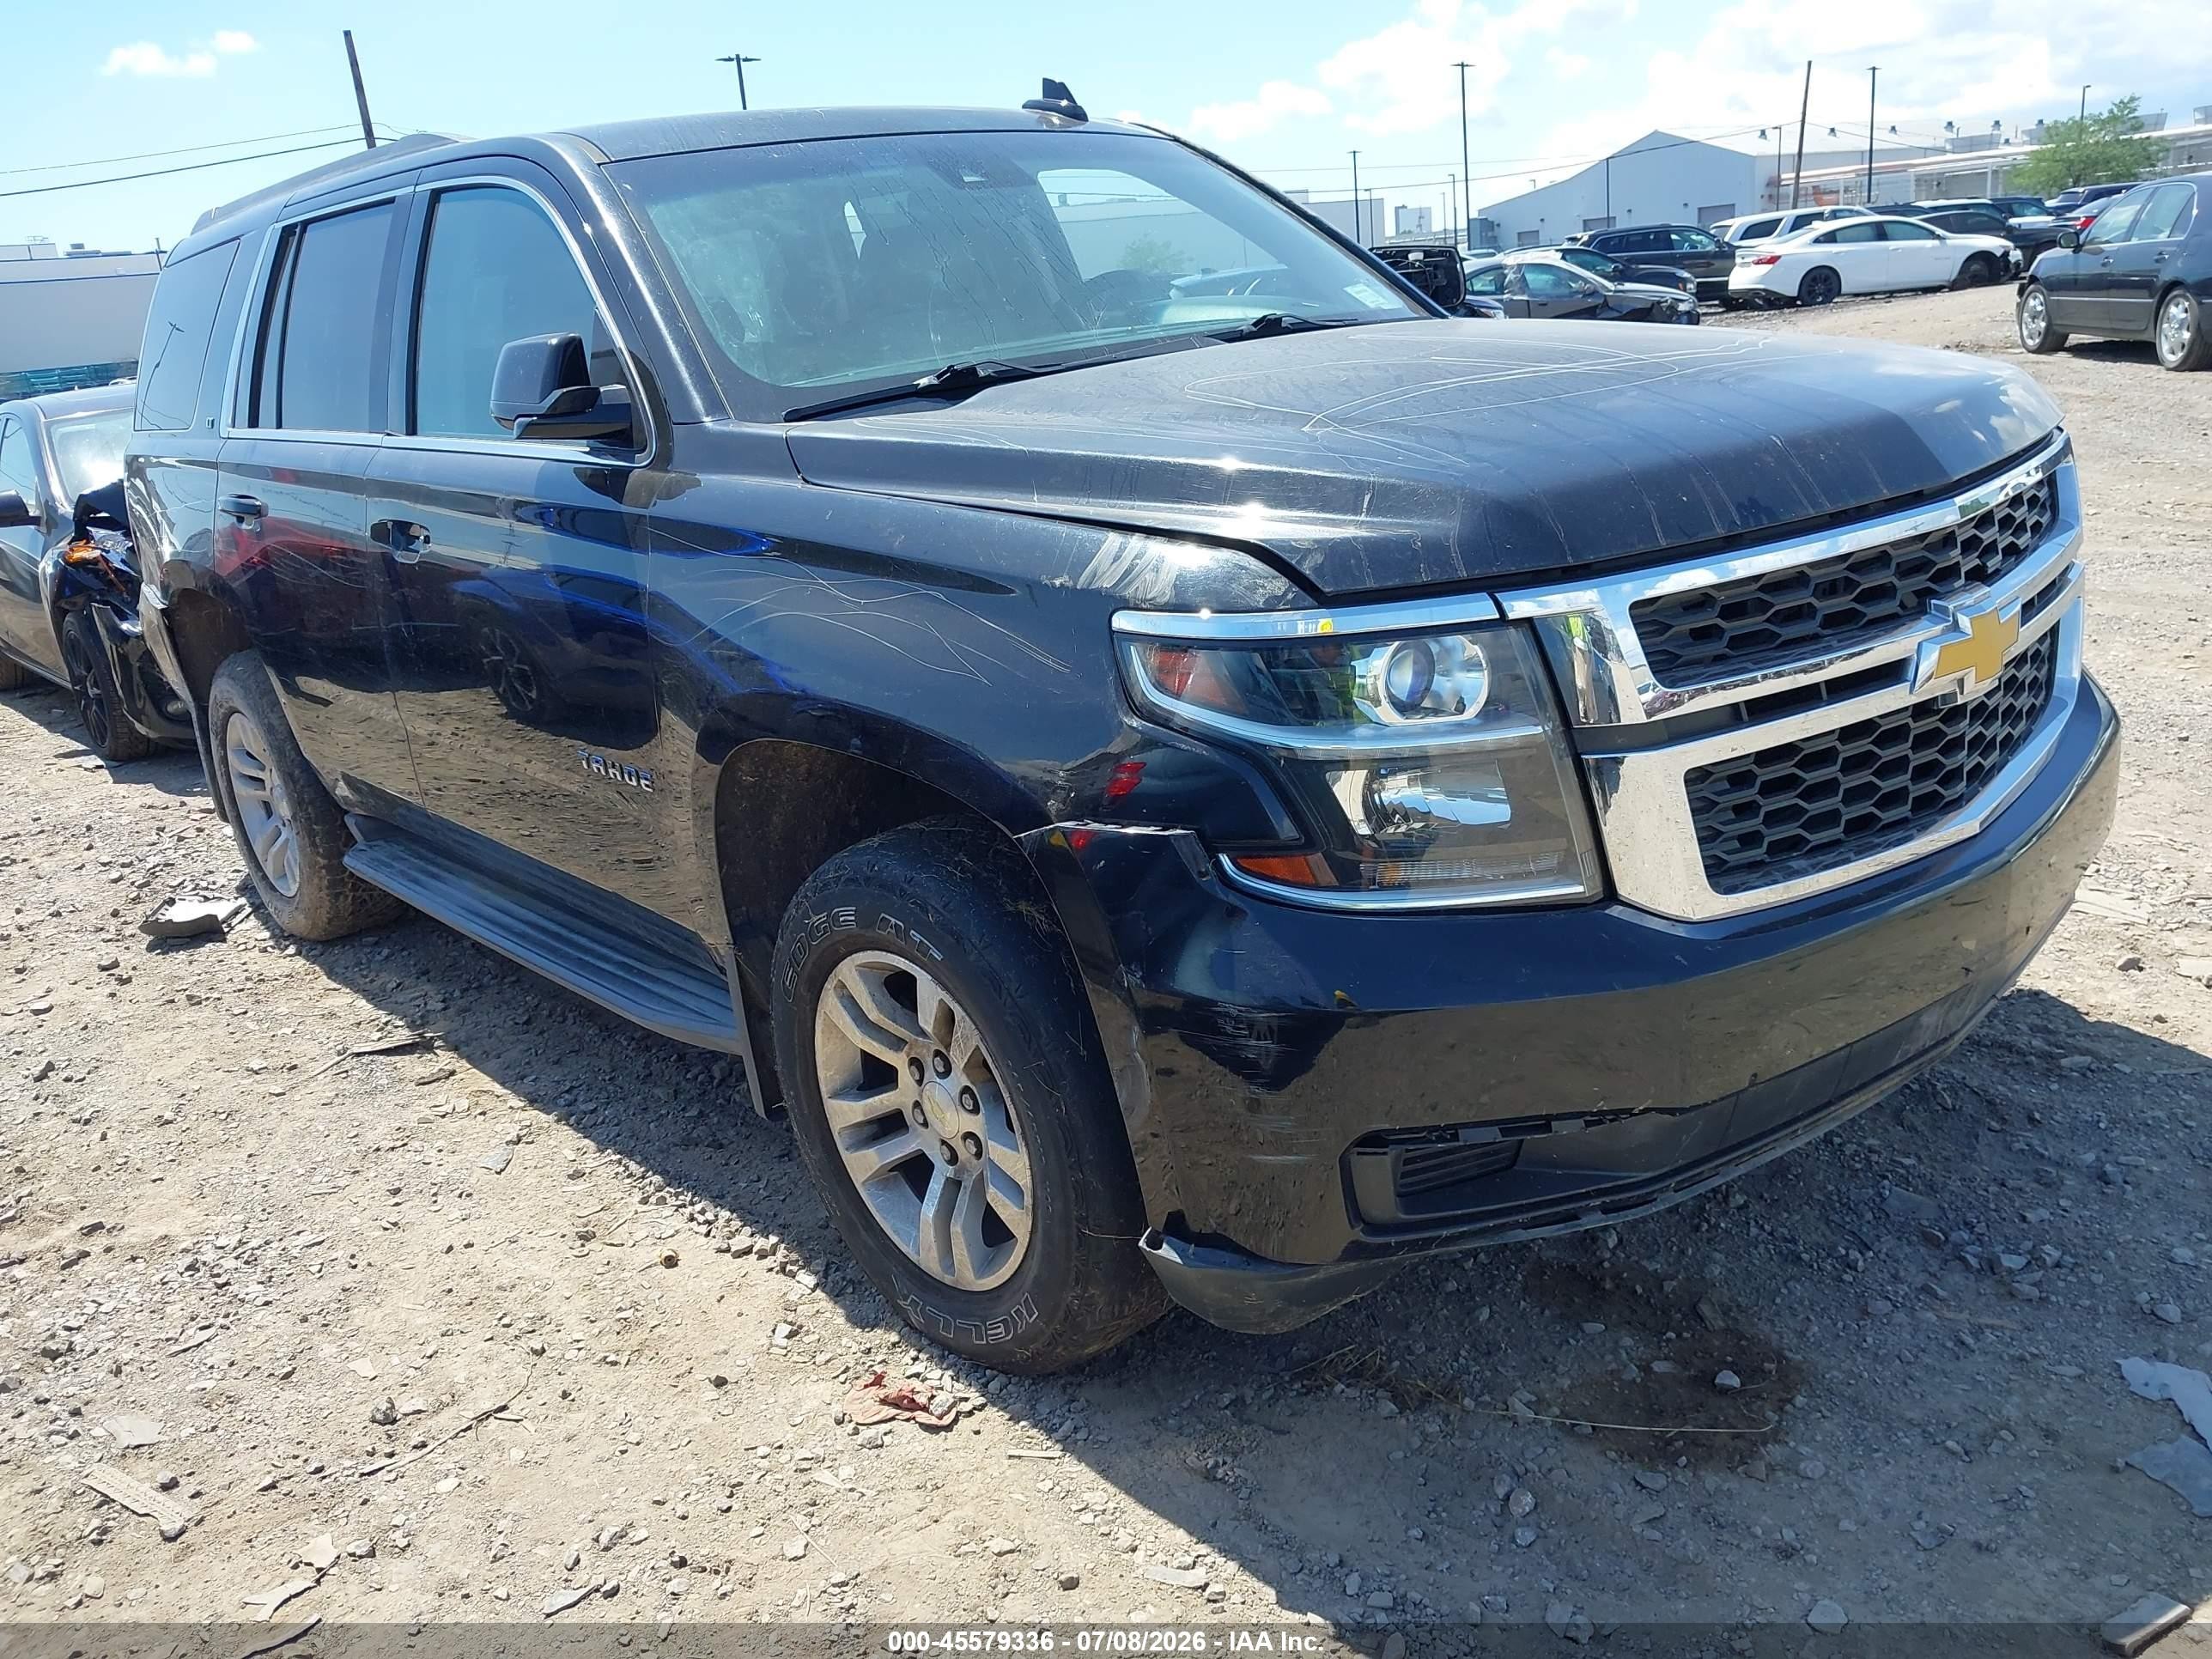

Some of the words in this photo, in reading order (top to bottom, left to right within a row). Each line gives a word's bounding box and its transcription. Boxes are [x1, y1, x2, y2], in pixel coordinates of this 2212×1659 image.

[577, 750, 653, 793] TAHOE
[781, 907, 857, 1003] EDGE
[876, 913, 944, 961] AT
[896, 1292, 1039, 1344] KELLY
